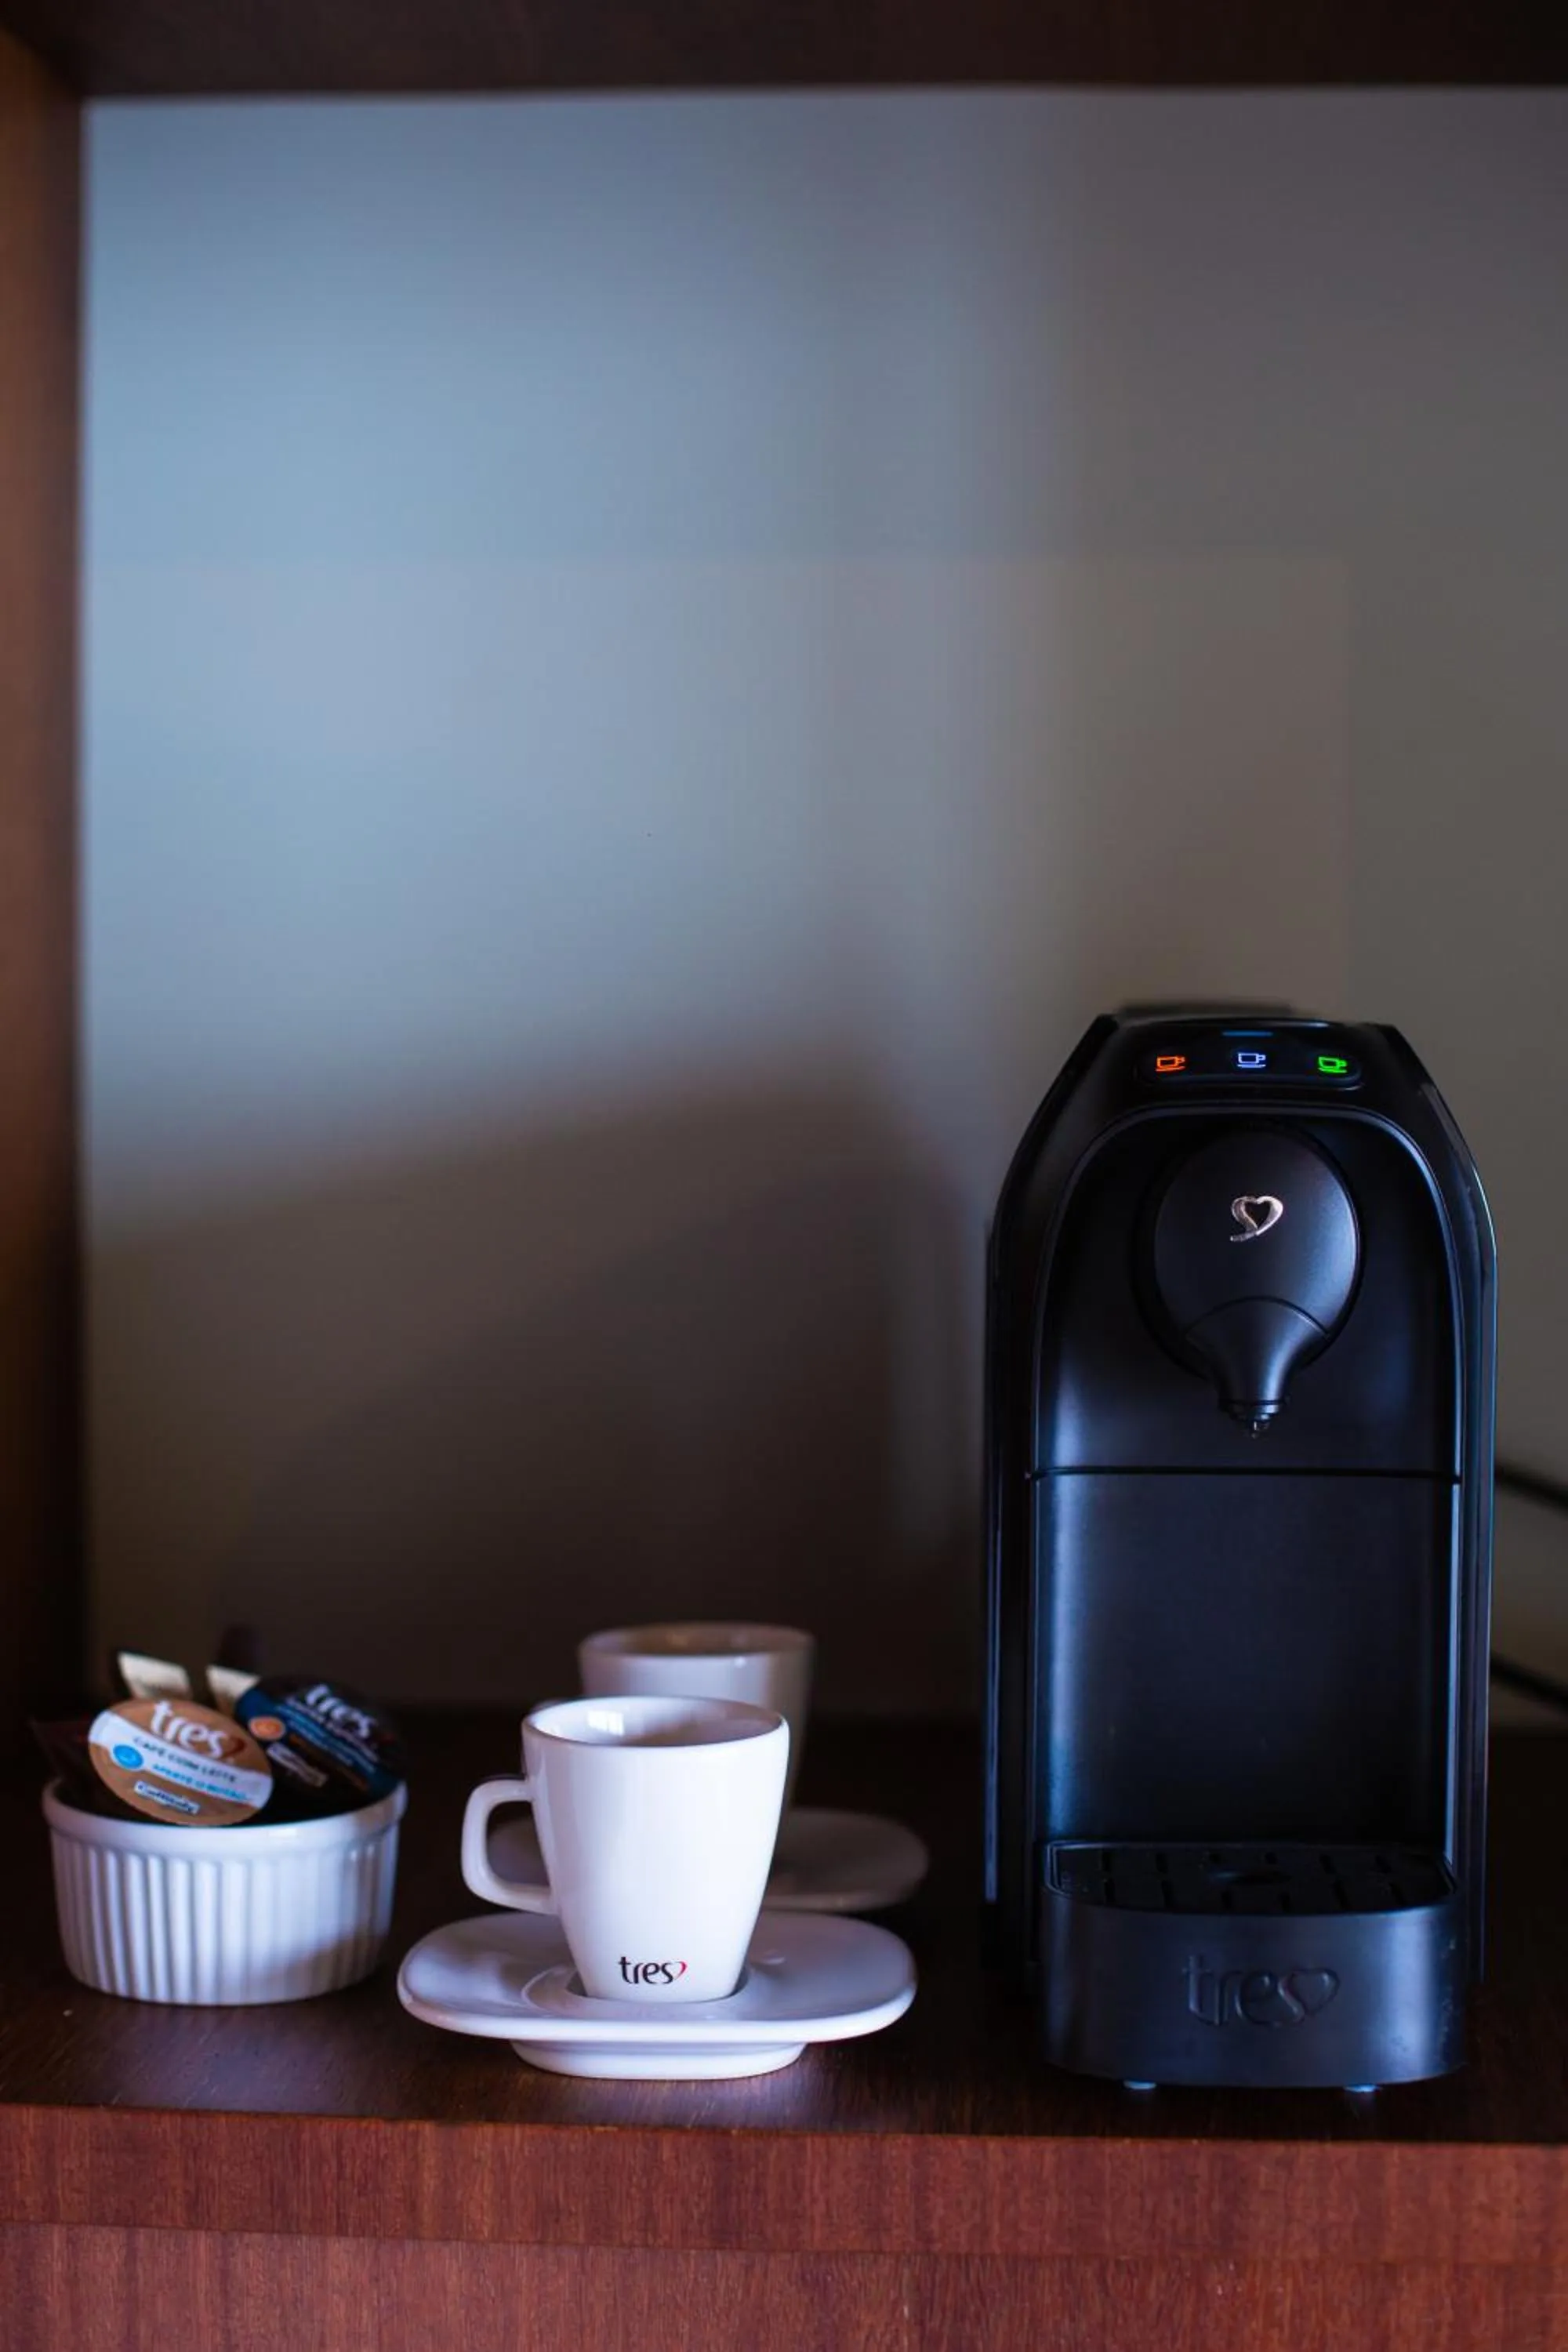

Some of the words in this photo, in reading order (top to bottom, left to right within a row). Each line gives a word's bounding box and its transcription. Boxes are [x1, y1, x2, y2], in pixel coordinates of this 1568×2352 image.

[151, 1700, 227, 1759] tres
[619, 1956, 675, 1984] tres
[1181, 1955, 1306, 2026] tres
